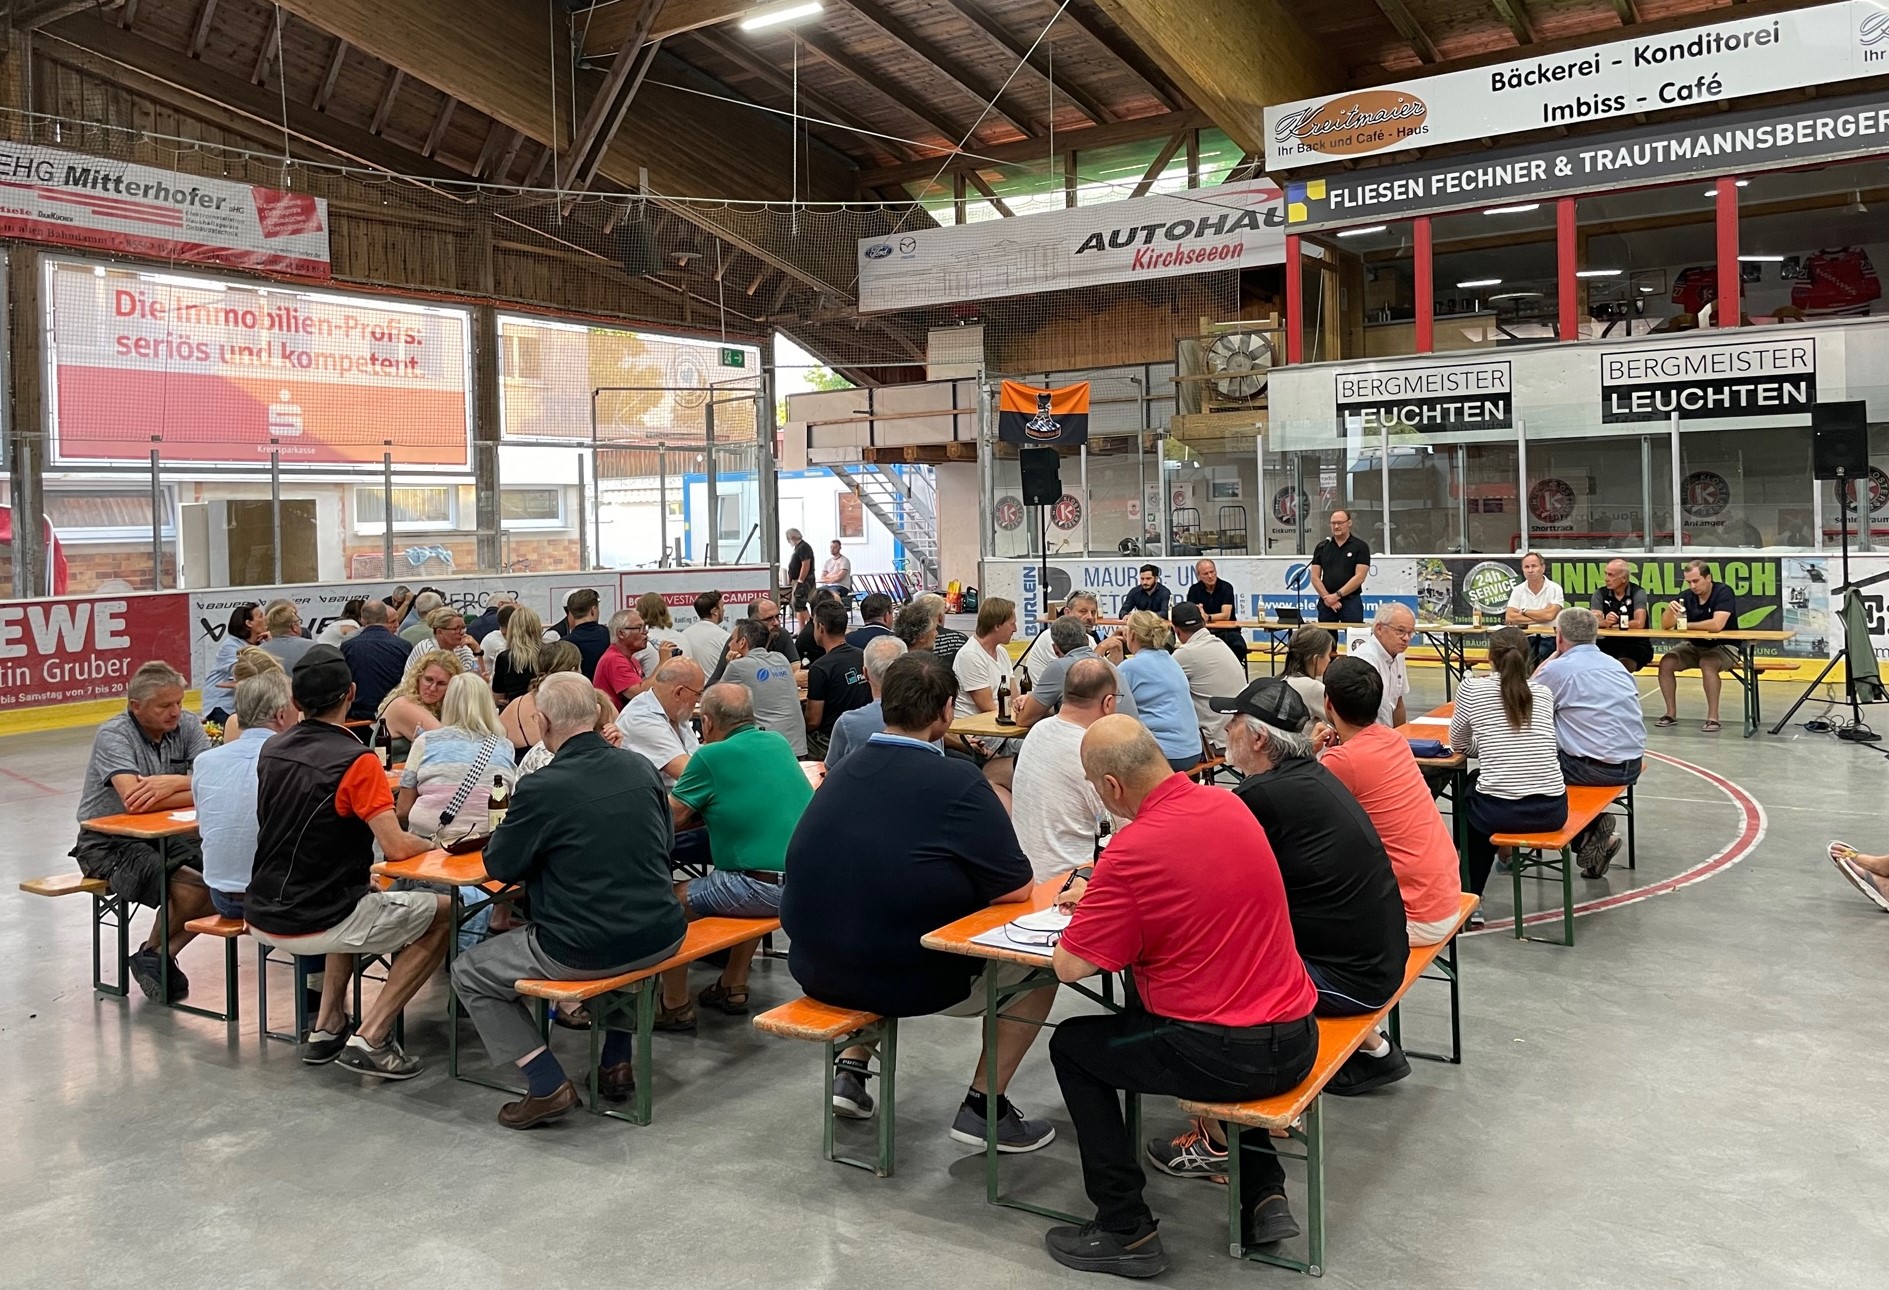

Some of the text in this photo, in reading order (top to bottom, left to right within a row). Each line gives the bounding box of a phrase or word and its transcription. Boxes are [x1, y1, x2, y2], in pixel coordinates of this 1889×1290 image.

[1491, 53, 1601, 92] Bäckerei
[1634, 21, 1780, 67] Konditorei
[1864, 50, 1887, 62] Ihr
[1543, 92, 1626, 123] Imbiss
[1659, 72, 1723, 104] Café
[1275, 97, 1425, 143] Kreitmaier
[1278, 145, 1294, 156] Ihr
[1297, 140, 1326, 154] Back
[1330, 135, 1352, 149] und
[1356, 129, 1385, 144] Café
[1396, 125, 1429, 138] Haus
[1330, 109, 1889, 210] FLIESEN FECHNER & TRAUTMANNSBERGER
[64, 165, 227, 210] Mitterhofer
[1075, 206, 1284, 255] AUTOHAU
[1132, 243, 1244, 271] Kirchseeon
[115, 289, 166, 321] Die
[116, 332, 211, 362] seriös
[1609, 347, 1808, 380] BERGMEISTER
[1342, 369, 1505, 398] BERGMEISTER
[1611, 381, 1807, 414] LEUCHTEN
[1344, 400, 1504, 428] LEUCHTEN
[1468, 578, 1517, 601] SERVICE
[1475, 570, 1502, 587] 24h
[327, 594, 370, 603] BAUER
[721, 592, 770, 603] CAMPUS
[1023, 566, 1037, 637] BURLEIN
[1491, 593, 1509, 604] TAGE
[43, 653, 131, 683] Gruber
[18, 691, 63, 702] Samstag
[66, 689, 84, 698] von
[87, 686, 92, 695] 7
[95, 684, 109, 694] bis
[111, 683, 123, 691] 20
